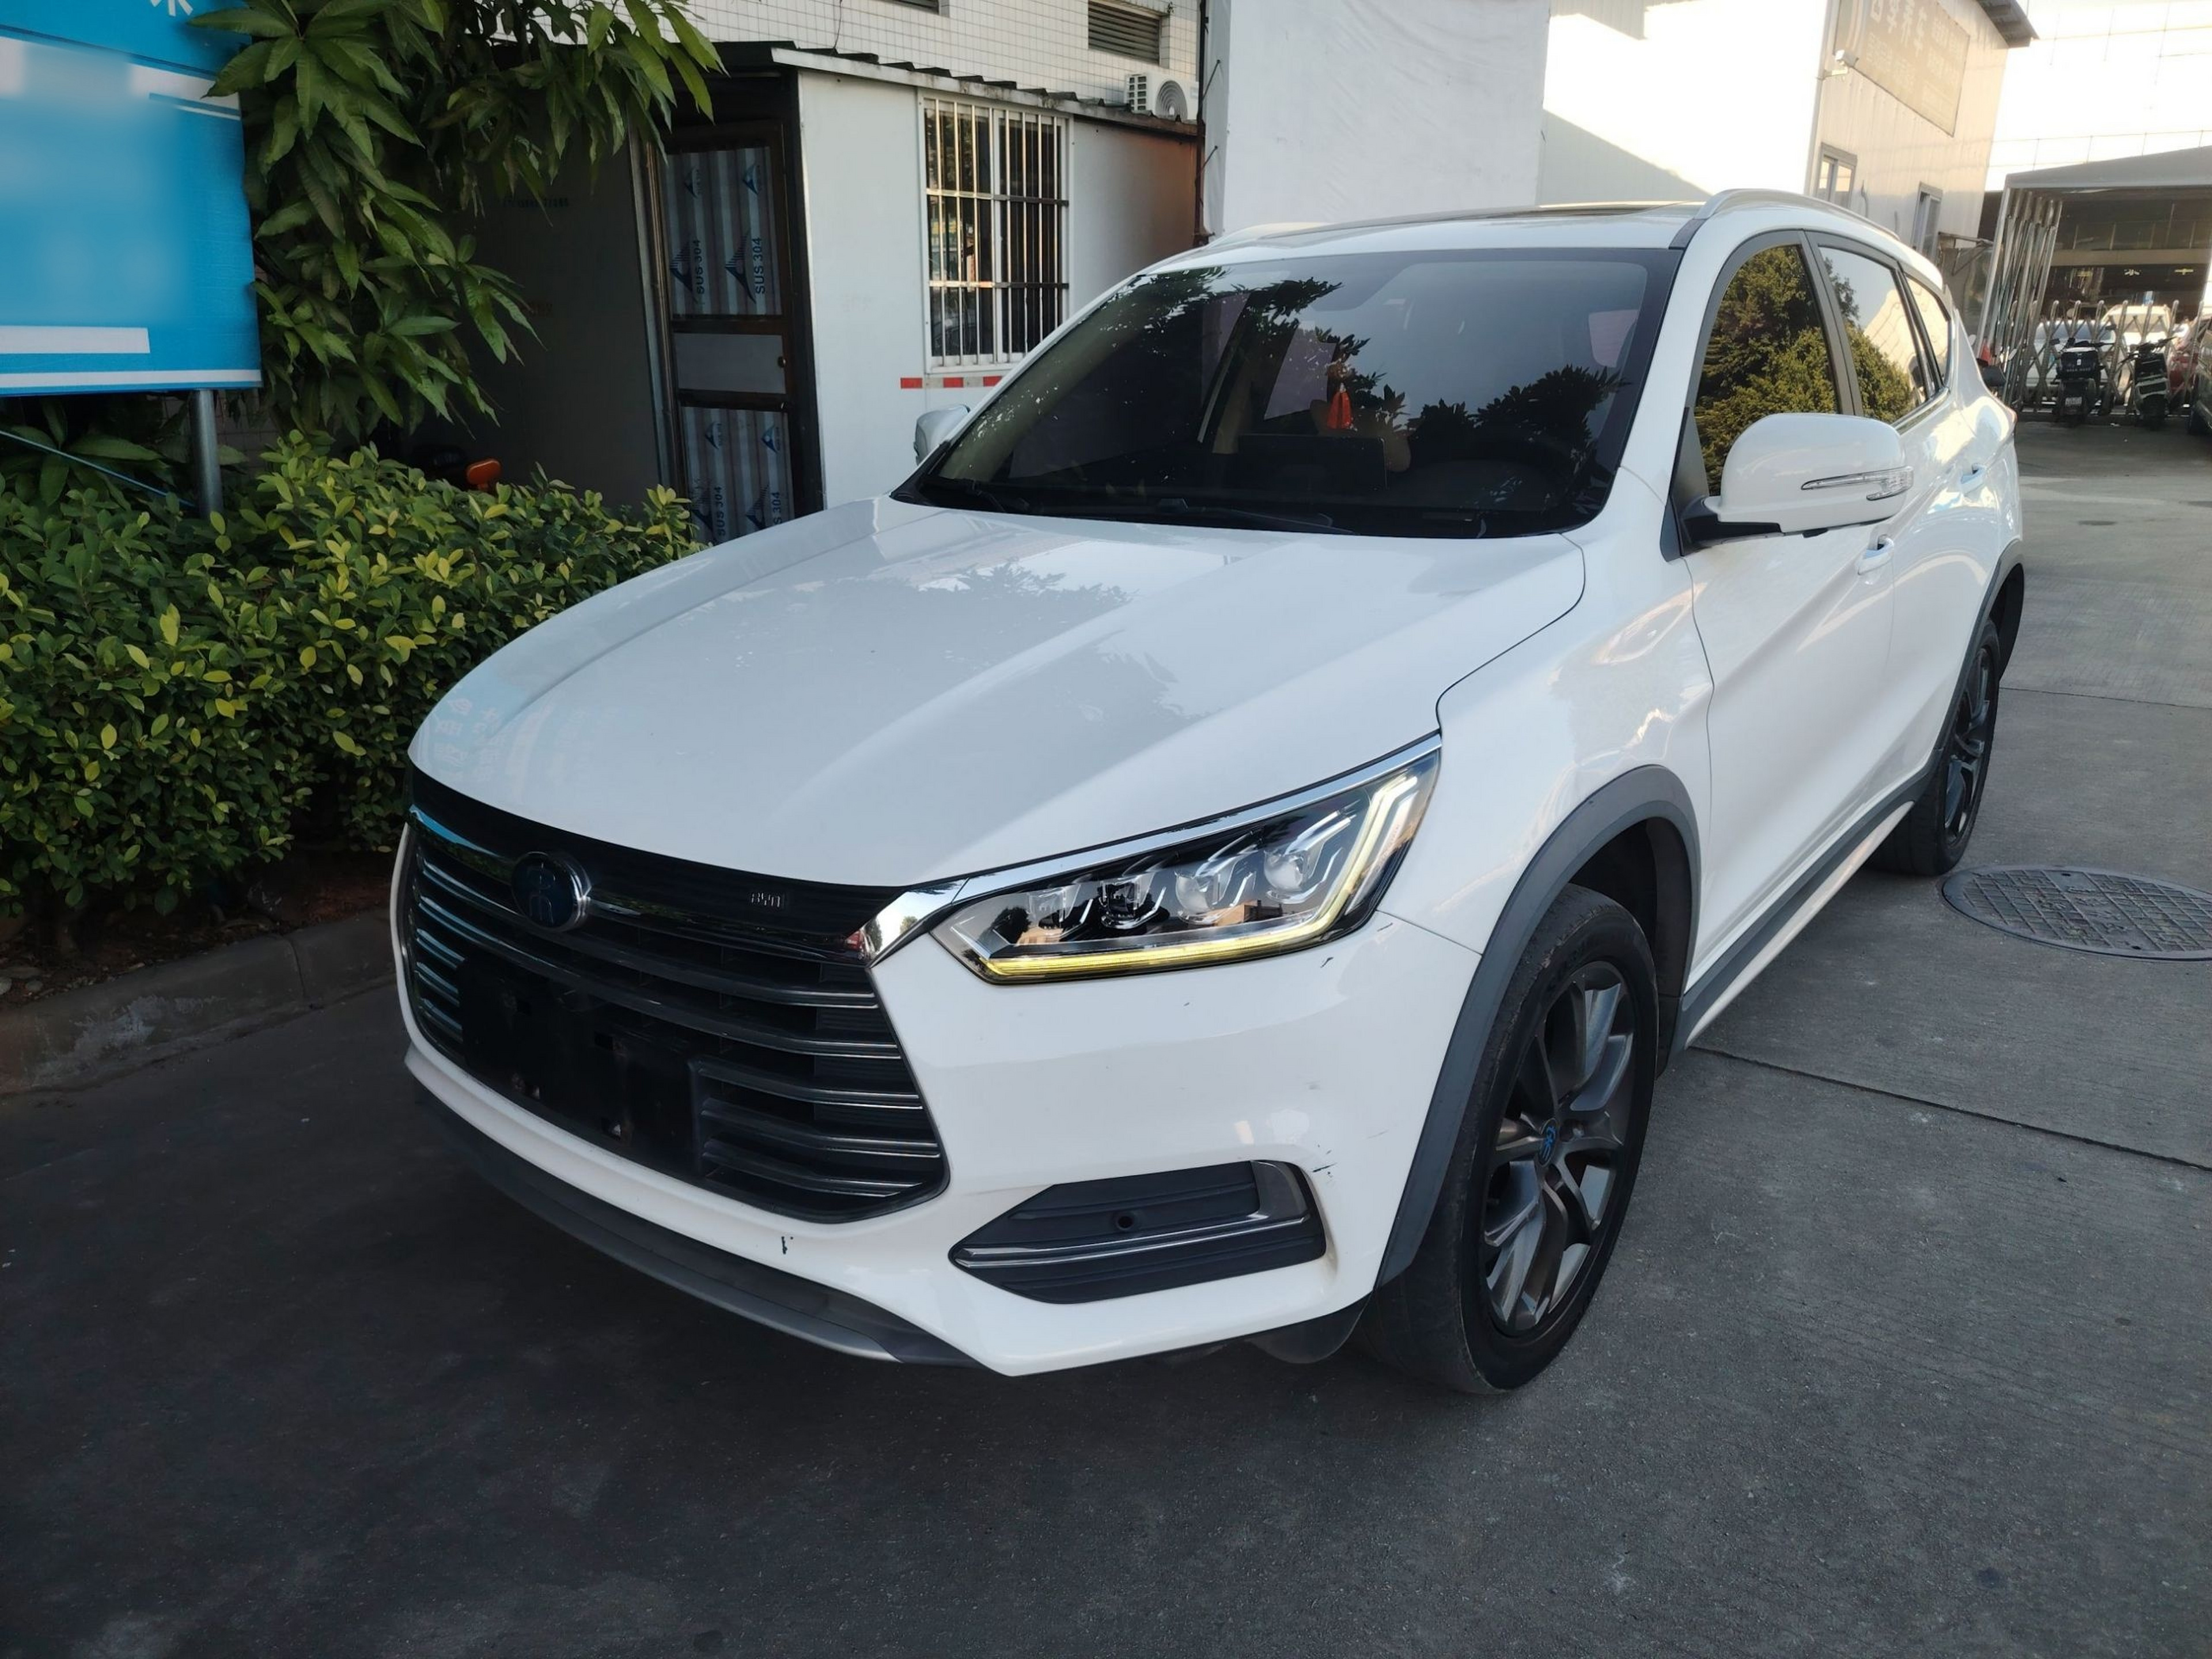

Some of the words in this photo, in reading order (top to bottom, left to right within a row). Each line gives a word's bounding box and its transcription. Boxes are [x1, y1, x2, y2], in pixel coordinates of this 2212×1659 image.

[693, 240, 702, 263] 304
[751, 237, 762, 262] 304
[696, 266, 705, 294] SUS
[754, 265, 766, 294] SUS
[714, 486, 724, 507] 304
[770, 492, 782, 513] 304
